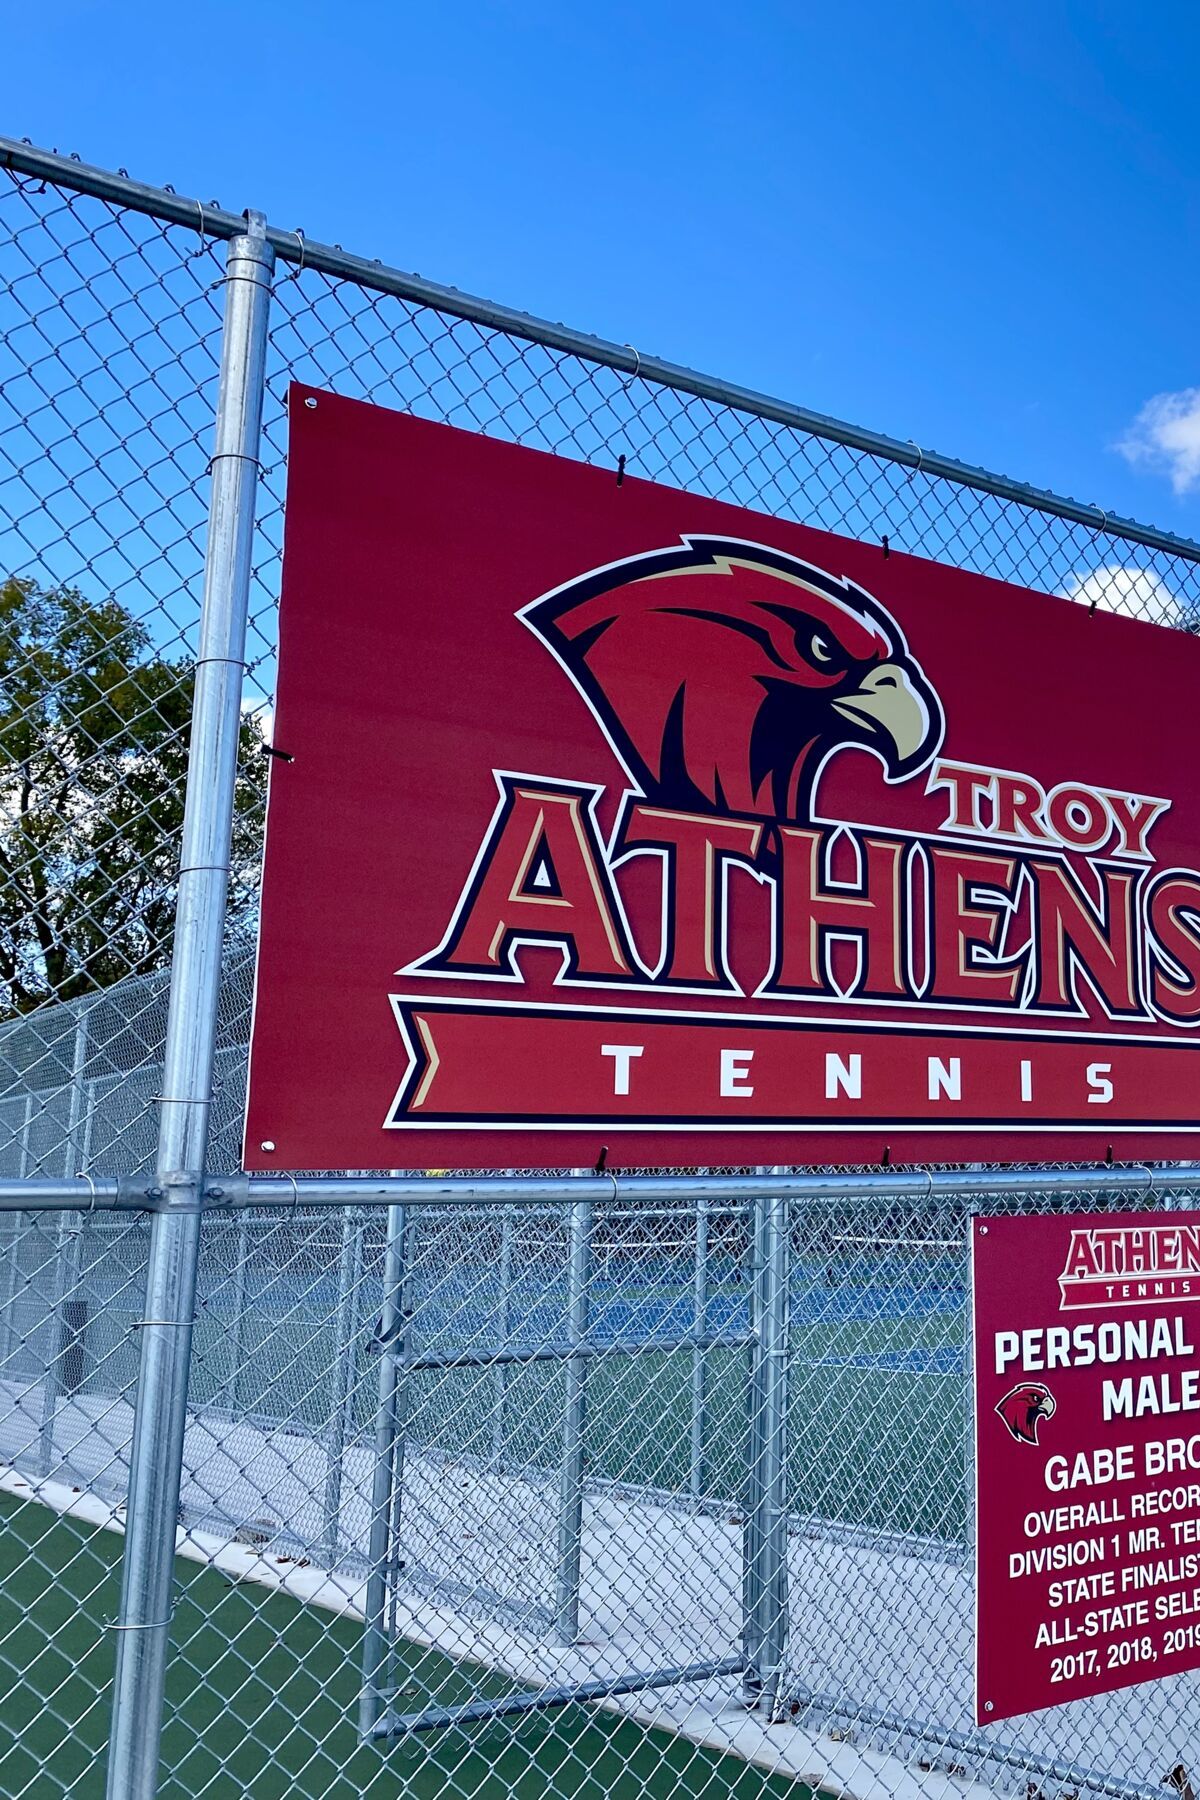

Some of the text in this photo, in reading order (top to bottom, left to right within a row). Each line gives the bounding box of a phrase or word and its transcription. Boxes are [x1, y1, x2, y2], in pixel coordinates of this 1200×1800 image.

[924, 758, 1173, 863] TROY
[600, 1043, 1116, 1104] TENNIS
[1106, 1280, 1192, 1298] TENNIS
[994, 1316, 1194, 1374] PERSONAL
[1102, 1370, 1200, 1421] MALE
[1045, 1444, 1134, 1492] GABE
[1024, 1498, 1125, 1538] OVERALL
[1009, 1534, 1105, 1578] DIVISION
[1111, 1534, 1120, 1558] 1
[1128, 1527, 1164, 1555] MR.
[1048, 1571, 1114, 1608] STATE
[1034, 1599, 1149, 1648] ALL-STATE
[1050, 1650, 1100, 1683] 2017,
[1107, 1636, 1158, 1669] 2018,
